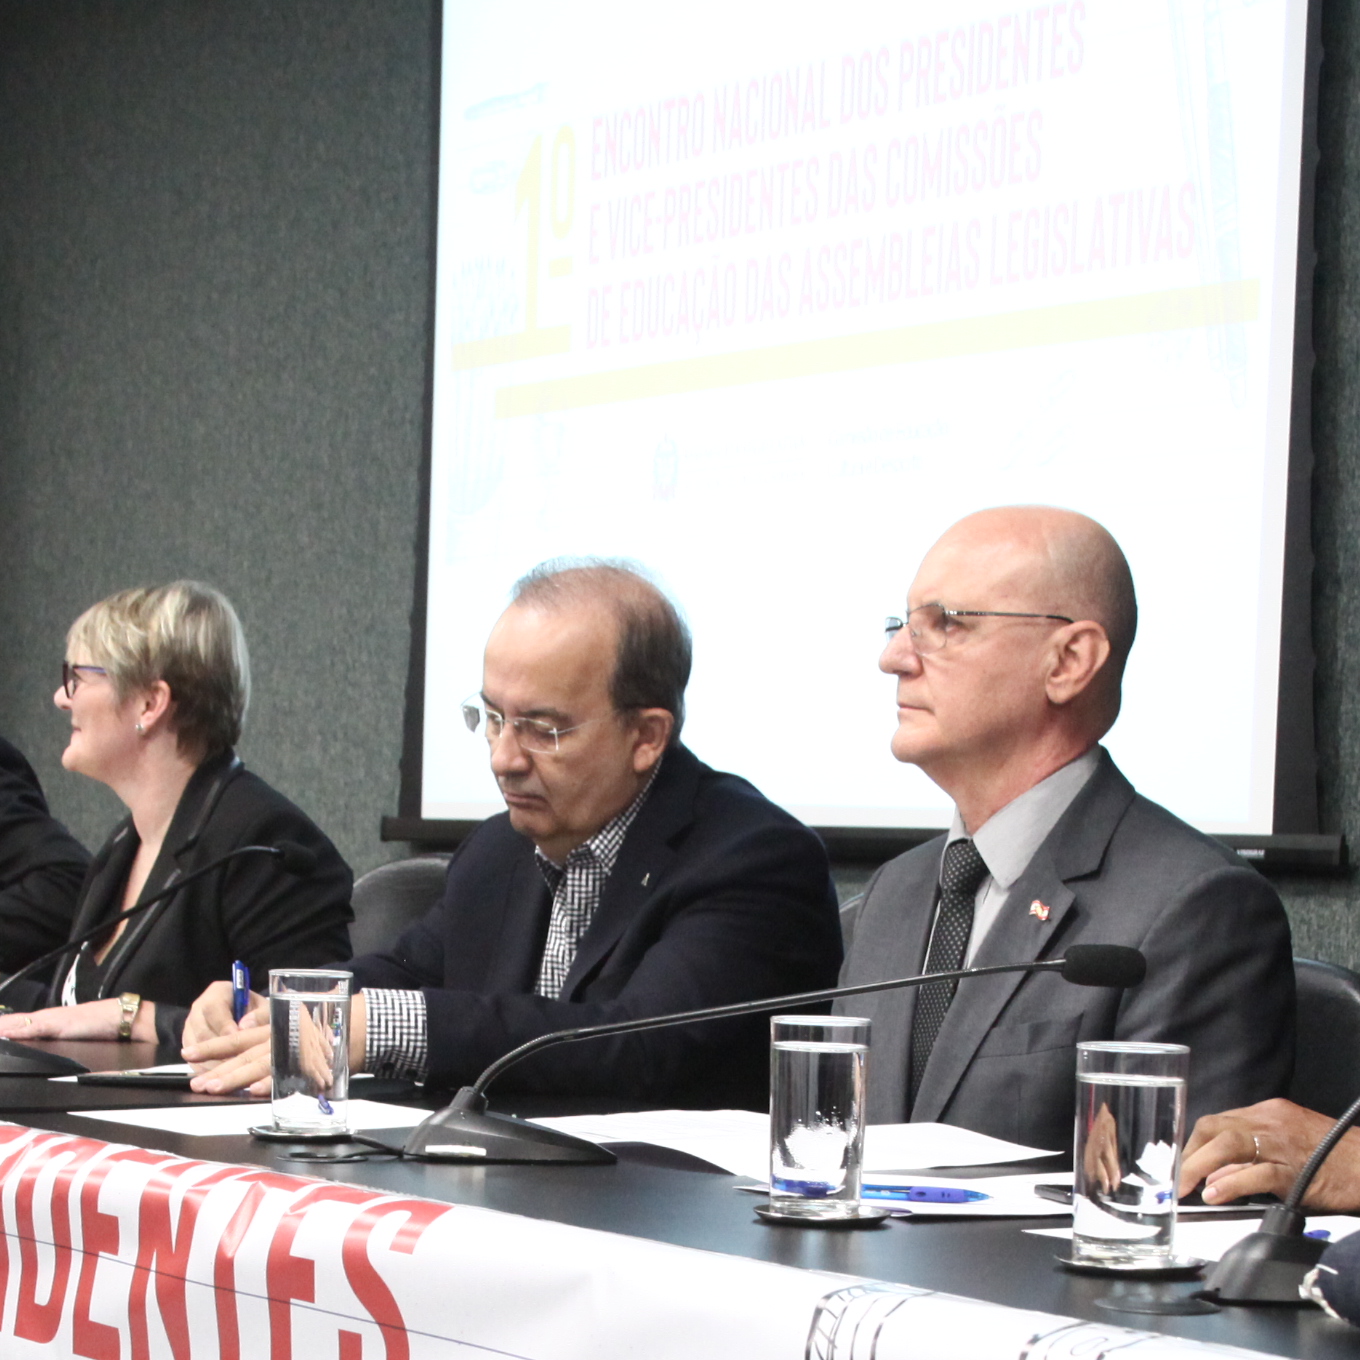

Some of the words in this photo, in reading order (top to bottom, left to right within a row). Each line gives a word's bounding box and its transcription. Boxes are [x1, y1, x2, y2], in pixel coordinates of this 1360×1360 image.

[591, 90, 706, 182] ENCONTRO
[713, 59, 830, 153] NACIONAL
[839, 45, 890, 125] DOS
[898, 0, 1086, 112] PRESIDENTES
[586, 284, 612, 349] DE
[619, 254, 738, 345] EDUCAÇÃO
[744, 251, 793, 324] DAS
[798, 217, 980, 316] ASSEMBLEIAS
[989, 181, 1197, 287] LEGISLATIVAS
[588, 202, 601, 265] E
[607, 155, 819, 265] VICE-PRESIDENTES
[827, 142, 877, 219] DAS
[885, 104, 1043, 209] COMISSÕES
